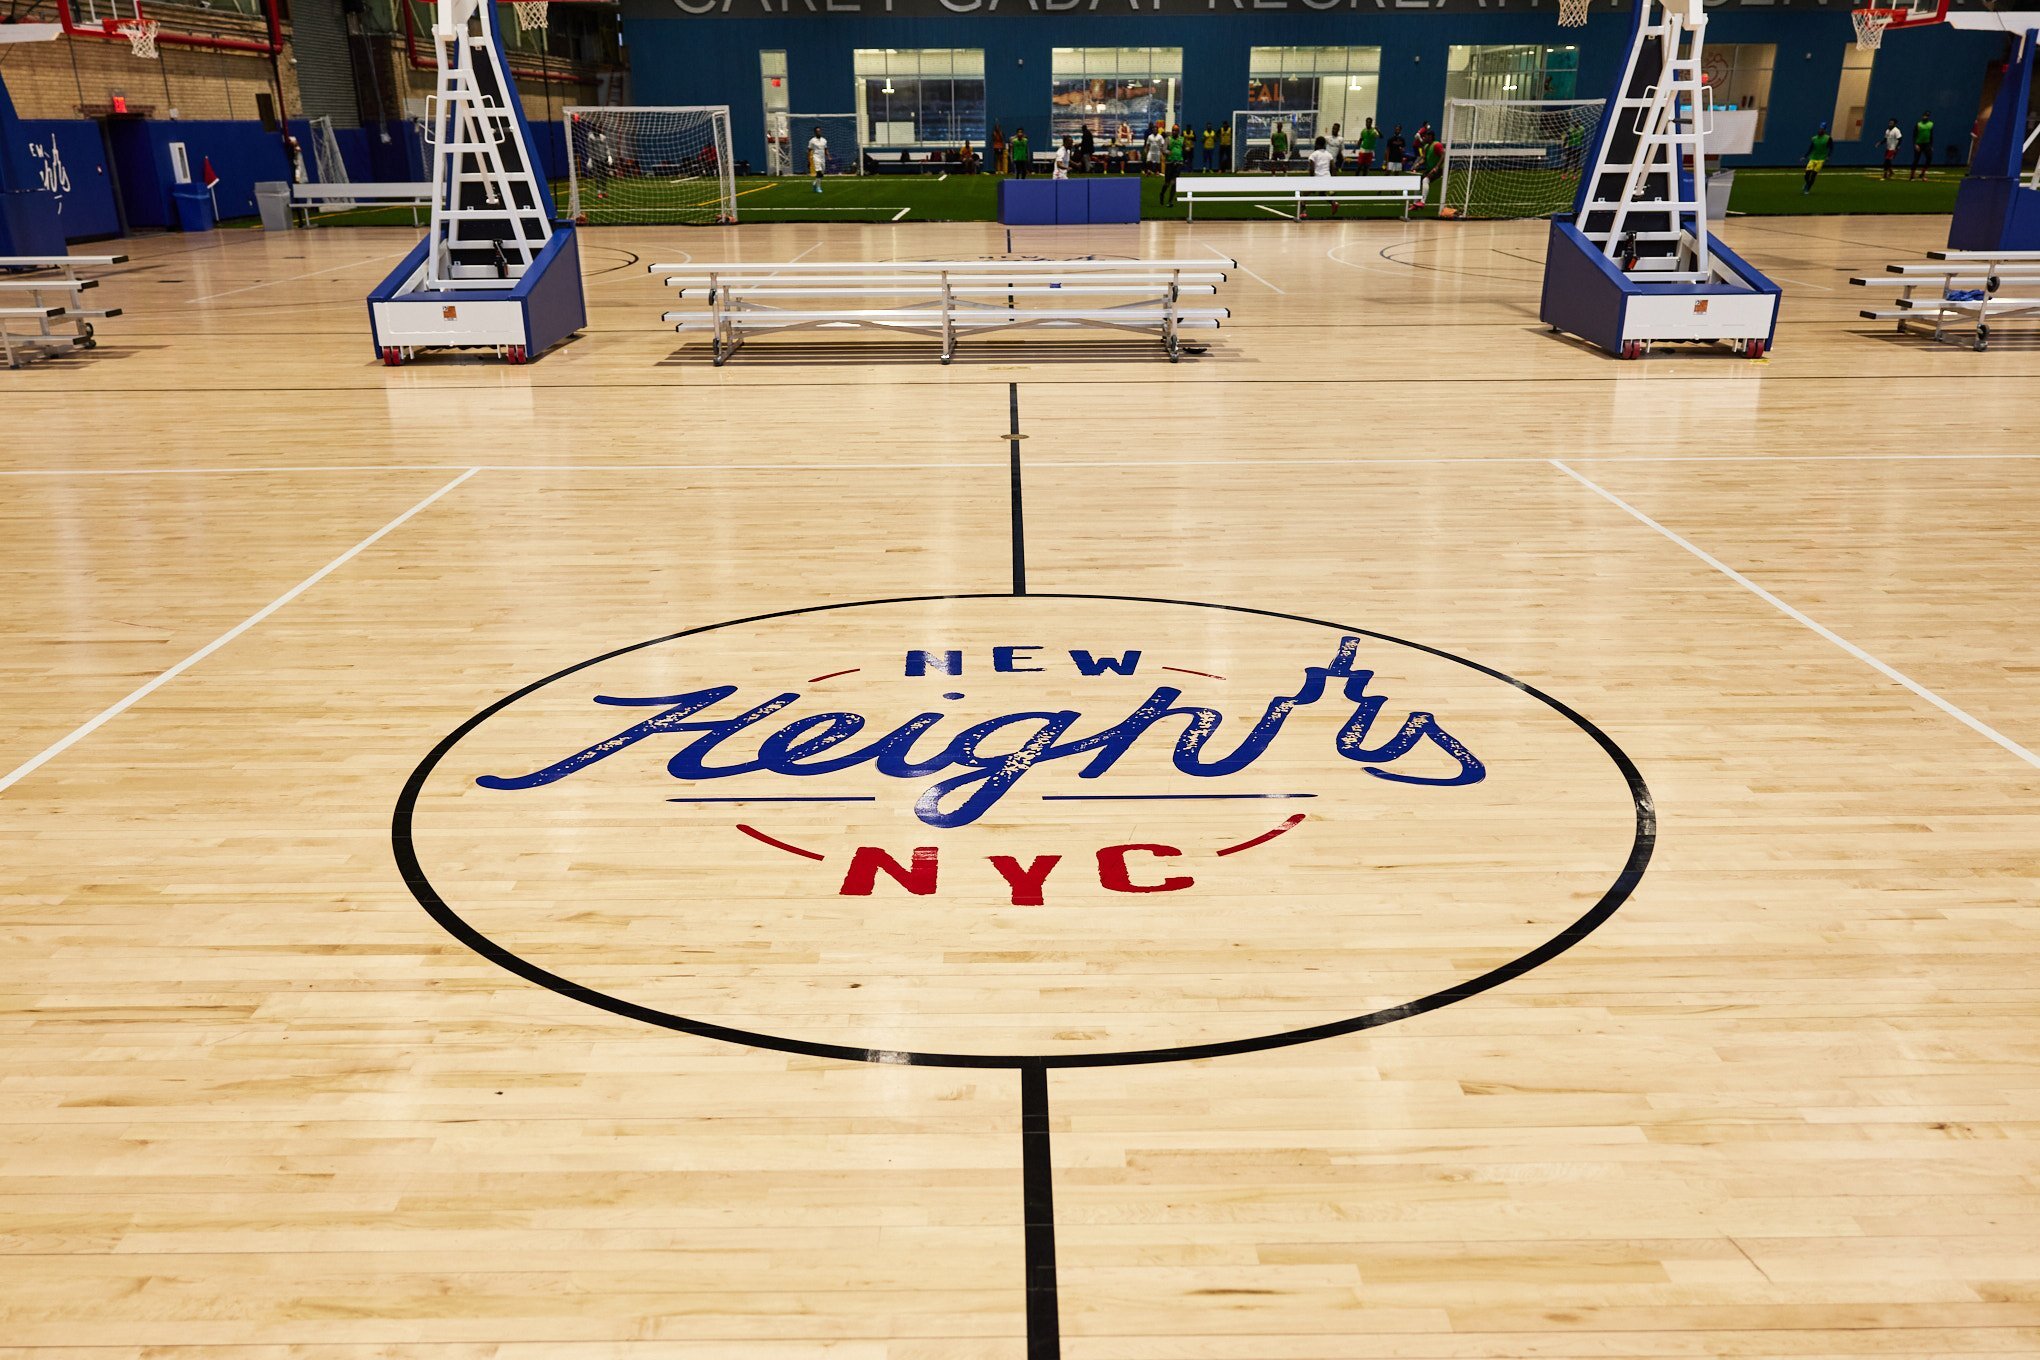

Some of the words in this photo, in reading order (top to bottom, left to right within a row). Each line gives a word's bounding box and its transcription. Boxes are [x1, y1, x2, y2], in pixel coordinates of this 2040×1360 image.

[28, 142, 45, 158] EW
[905, 646, 1141, 677] NEW
[476, 636, 1486, 829] Heights
[839, 844, 1195, 907] NYC
